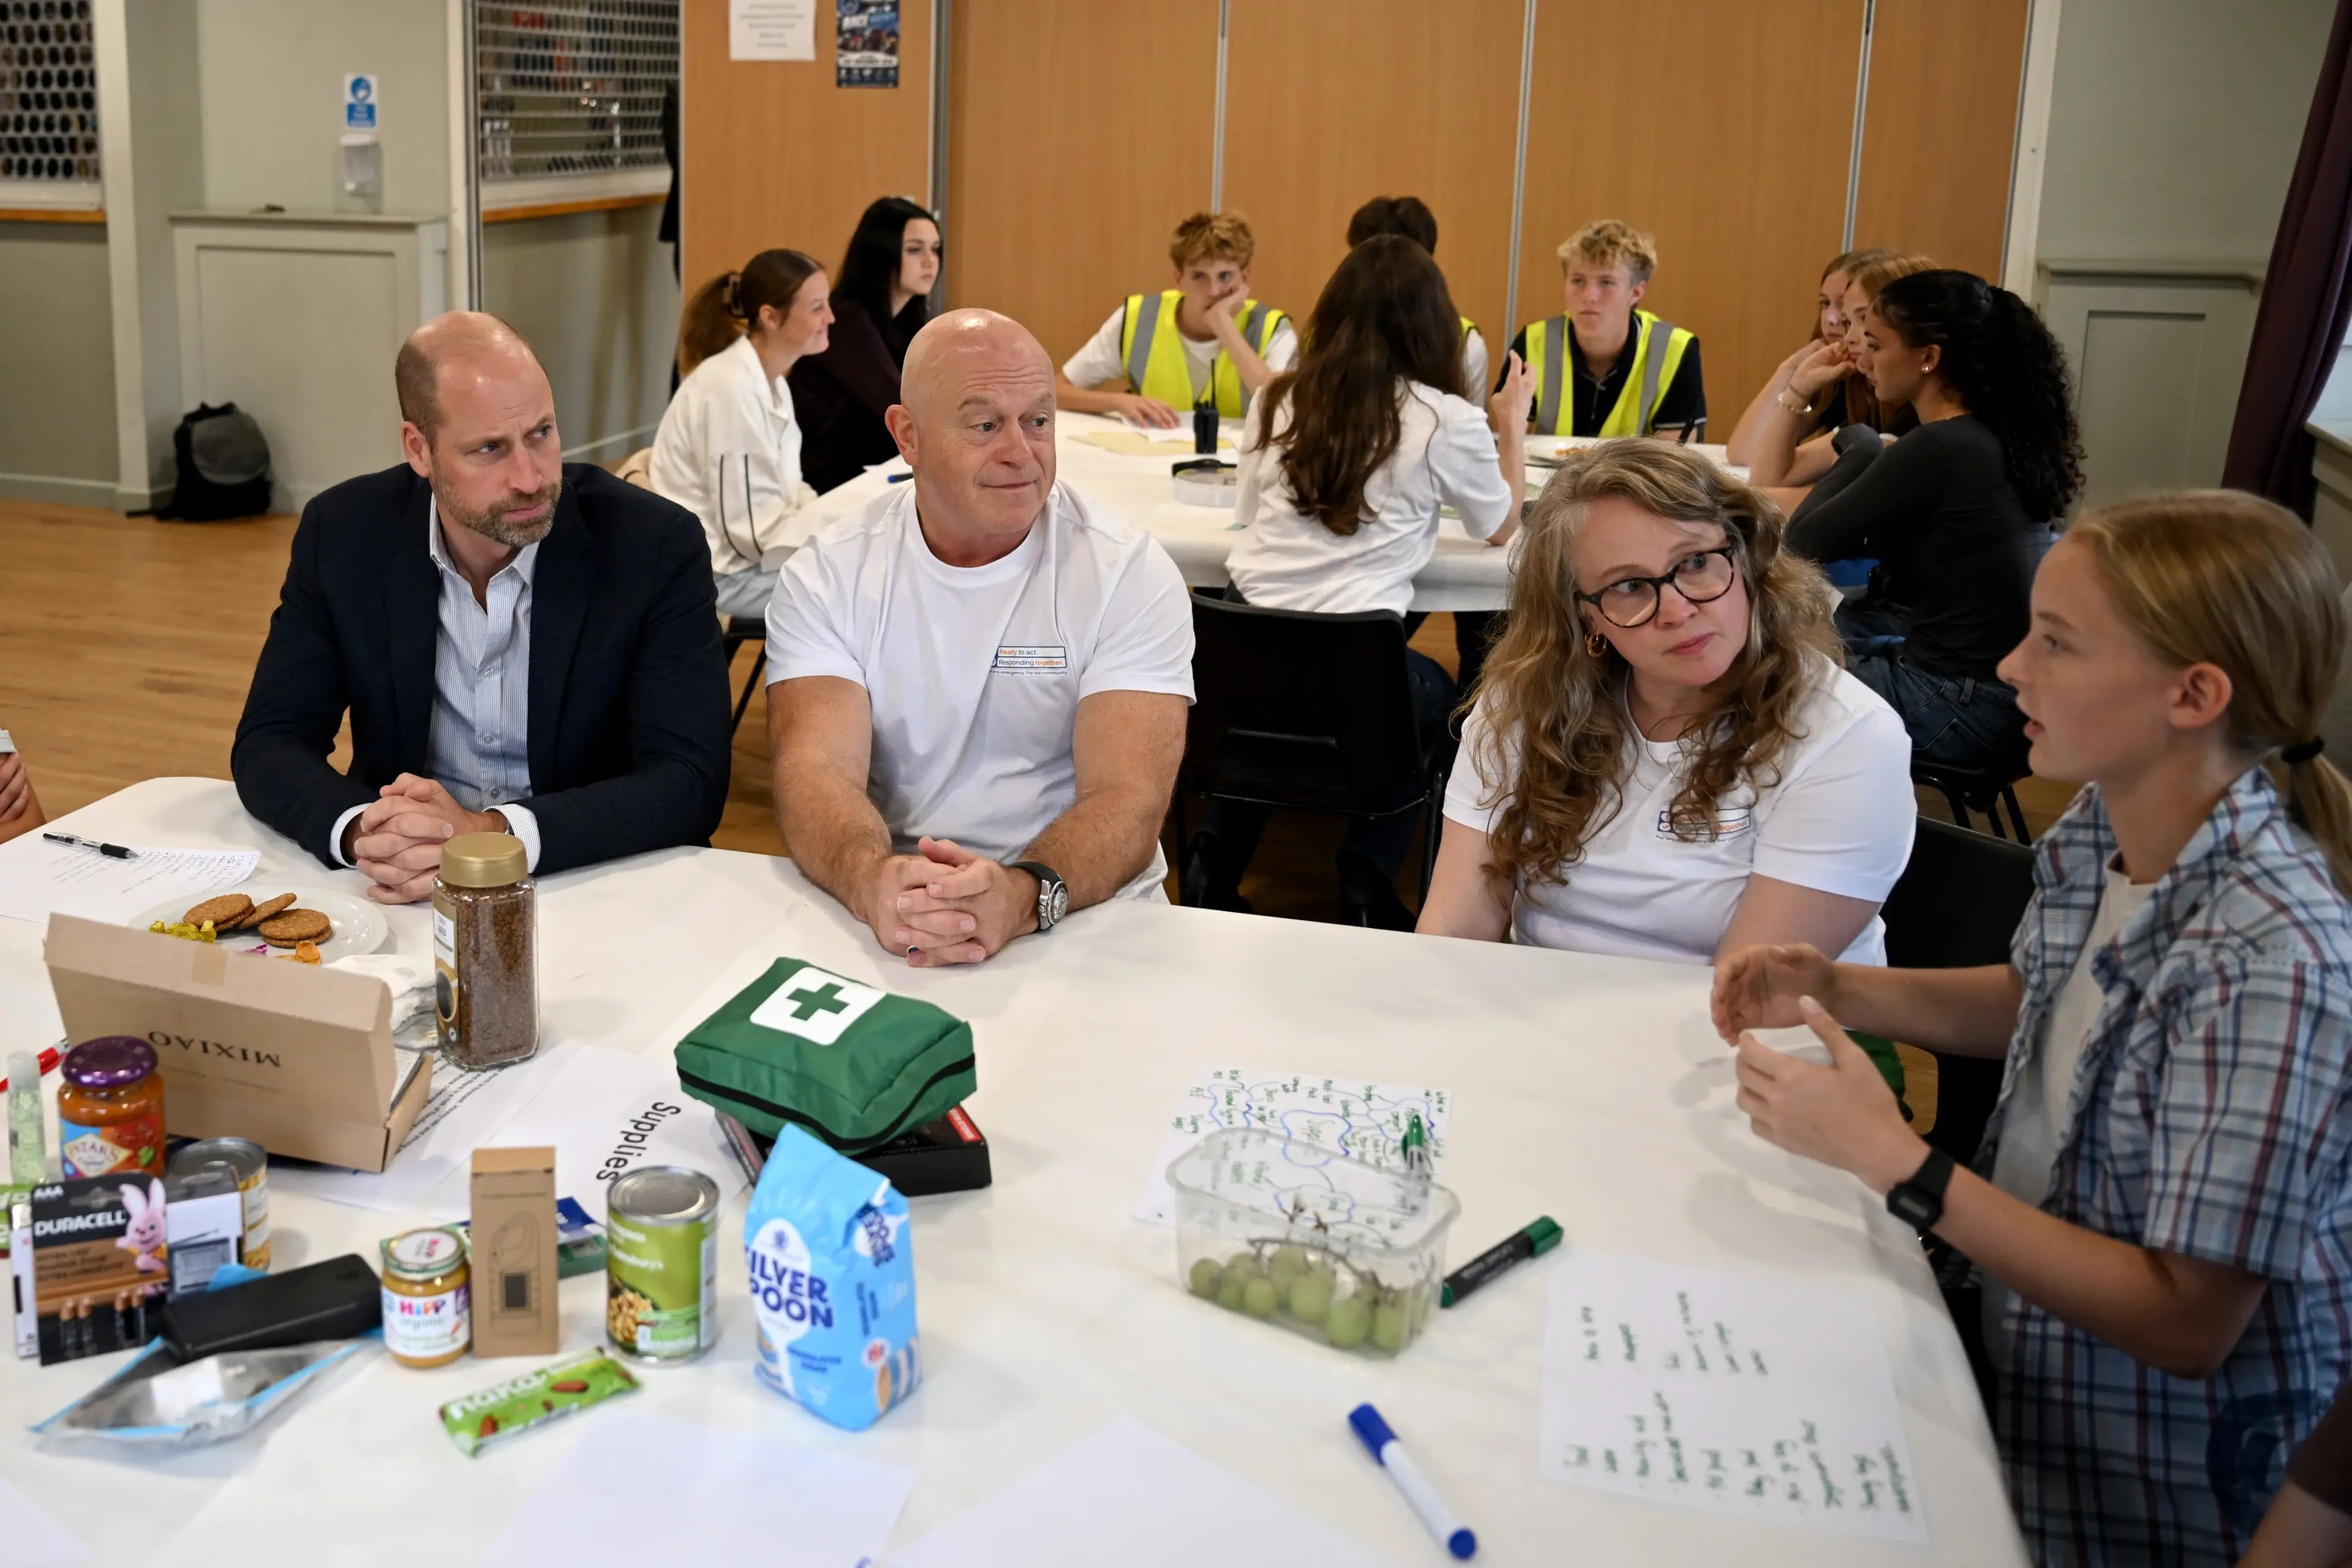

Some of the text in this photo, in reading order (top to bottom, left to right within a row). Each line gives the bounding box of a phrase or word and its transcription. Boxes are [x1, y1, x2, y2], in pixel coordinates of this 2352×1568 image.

[148, 1031, 281, 1068] MIXIAO
[596, 1102, 681, 1180] Supplies
[34, 1185, 63, 1196] AAA
[35, 1210, 126, 1236] DURACELL
[744, 1245, 829, 1303] ILVER
[748, 1277, 833, 1328] POON
